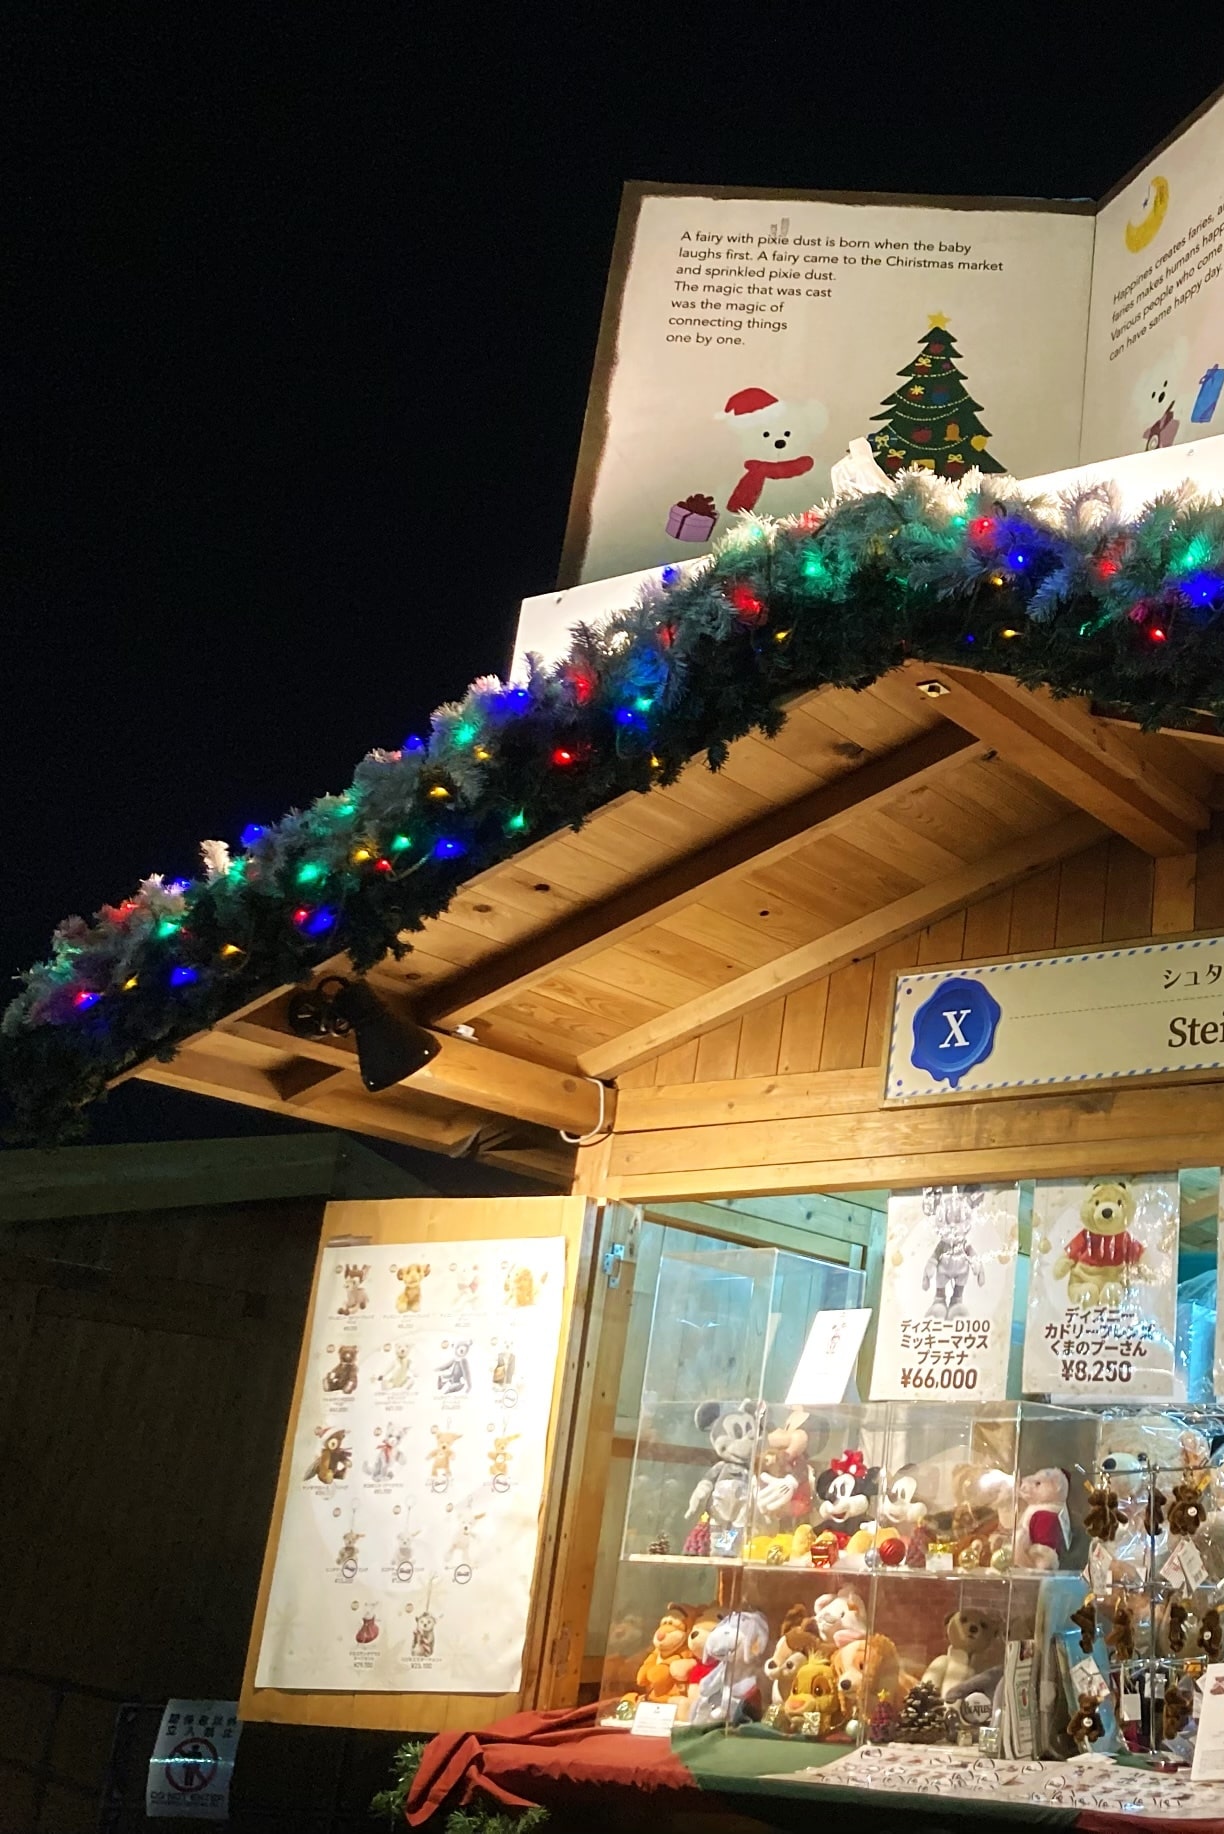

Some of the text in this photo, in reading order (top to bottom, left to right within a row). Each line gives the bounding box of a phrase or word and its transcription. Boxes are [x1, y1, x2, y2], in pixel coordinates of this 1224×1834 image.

[680, 230, 972, 256] A fairy with pixie dust is born when the baby
[678, 246, 1004, 272] laughs first. A fairy came to the Chiristmas market
[1154, 237, 1186, 269] creates
[675, 263, 837, 282] and sprinkled pixie dust.
[1136, 275, 1164, 305] makes
[1166, 245, 1200, 278] humans
[673, 280, 833, 299] The magic that was cast
[1111, 313, 1141, 341] Various
[1143, 286, 1173, 319] people
[1176, 267, 1195, 288] who
[1198, 243, 1223, 269] come
[671, 298, 785, 315] was the magic of
[1110, 264, 1222, 361] can have same happy day.
[668, 317, 788, 333] connecting things
[665, 331, 745, 347] one by one.
[939, 1010, 970, 1048] X
[1065, 1307, 1135, 1323] ディズニー
[901, 1319, 990, 1334] ディズニーD100
[901, 1335, 988, 1350] ミッキーマウス
[1051, 1340, 1147, 1356] くまのプーさん
[918, 1350, 968, 1366] プラチナ
[901, 1367, 977, 1390] ¥66,000
[1062, 1360, 1131, 1382] ¥8,250
